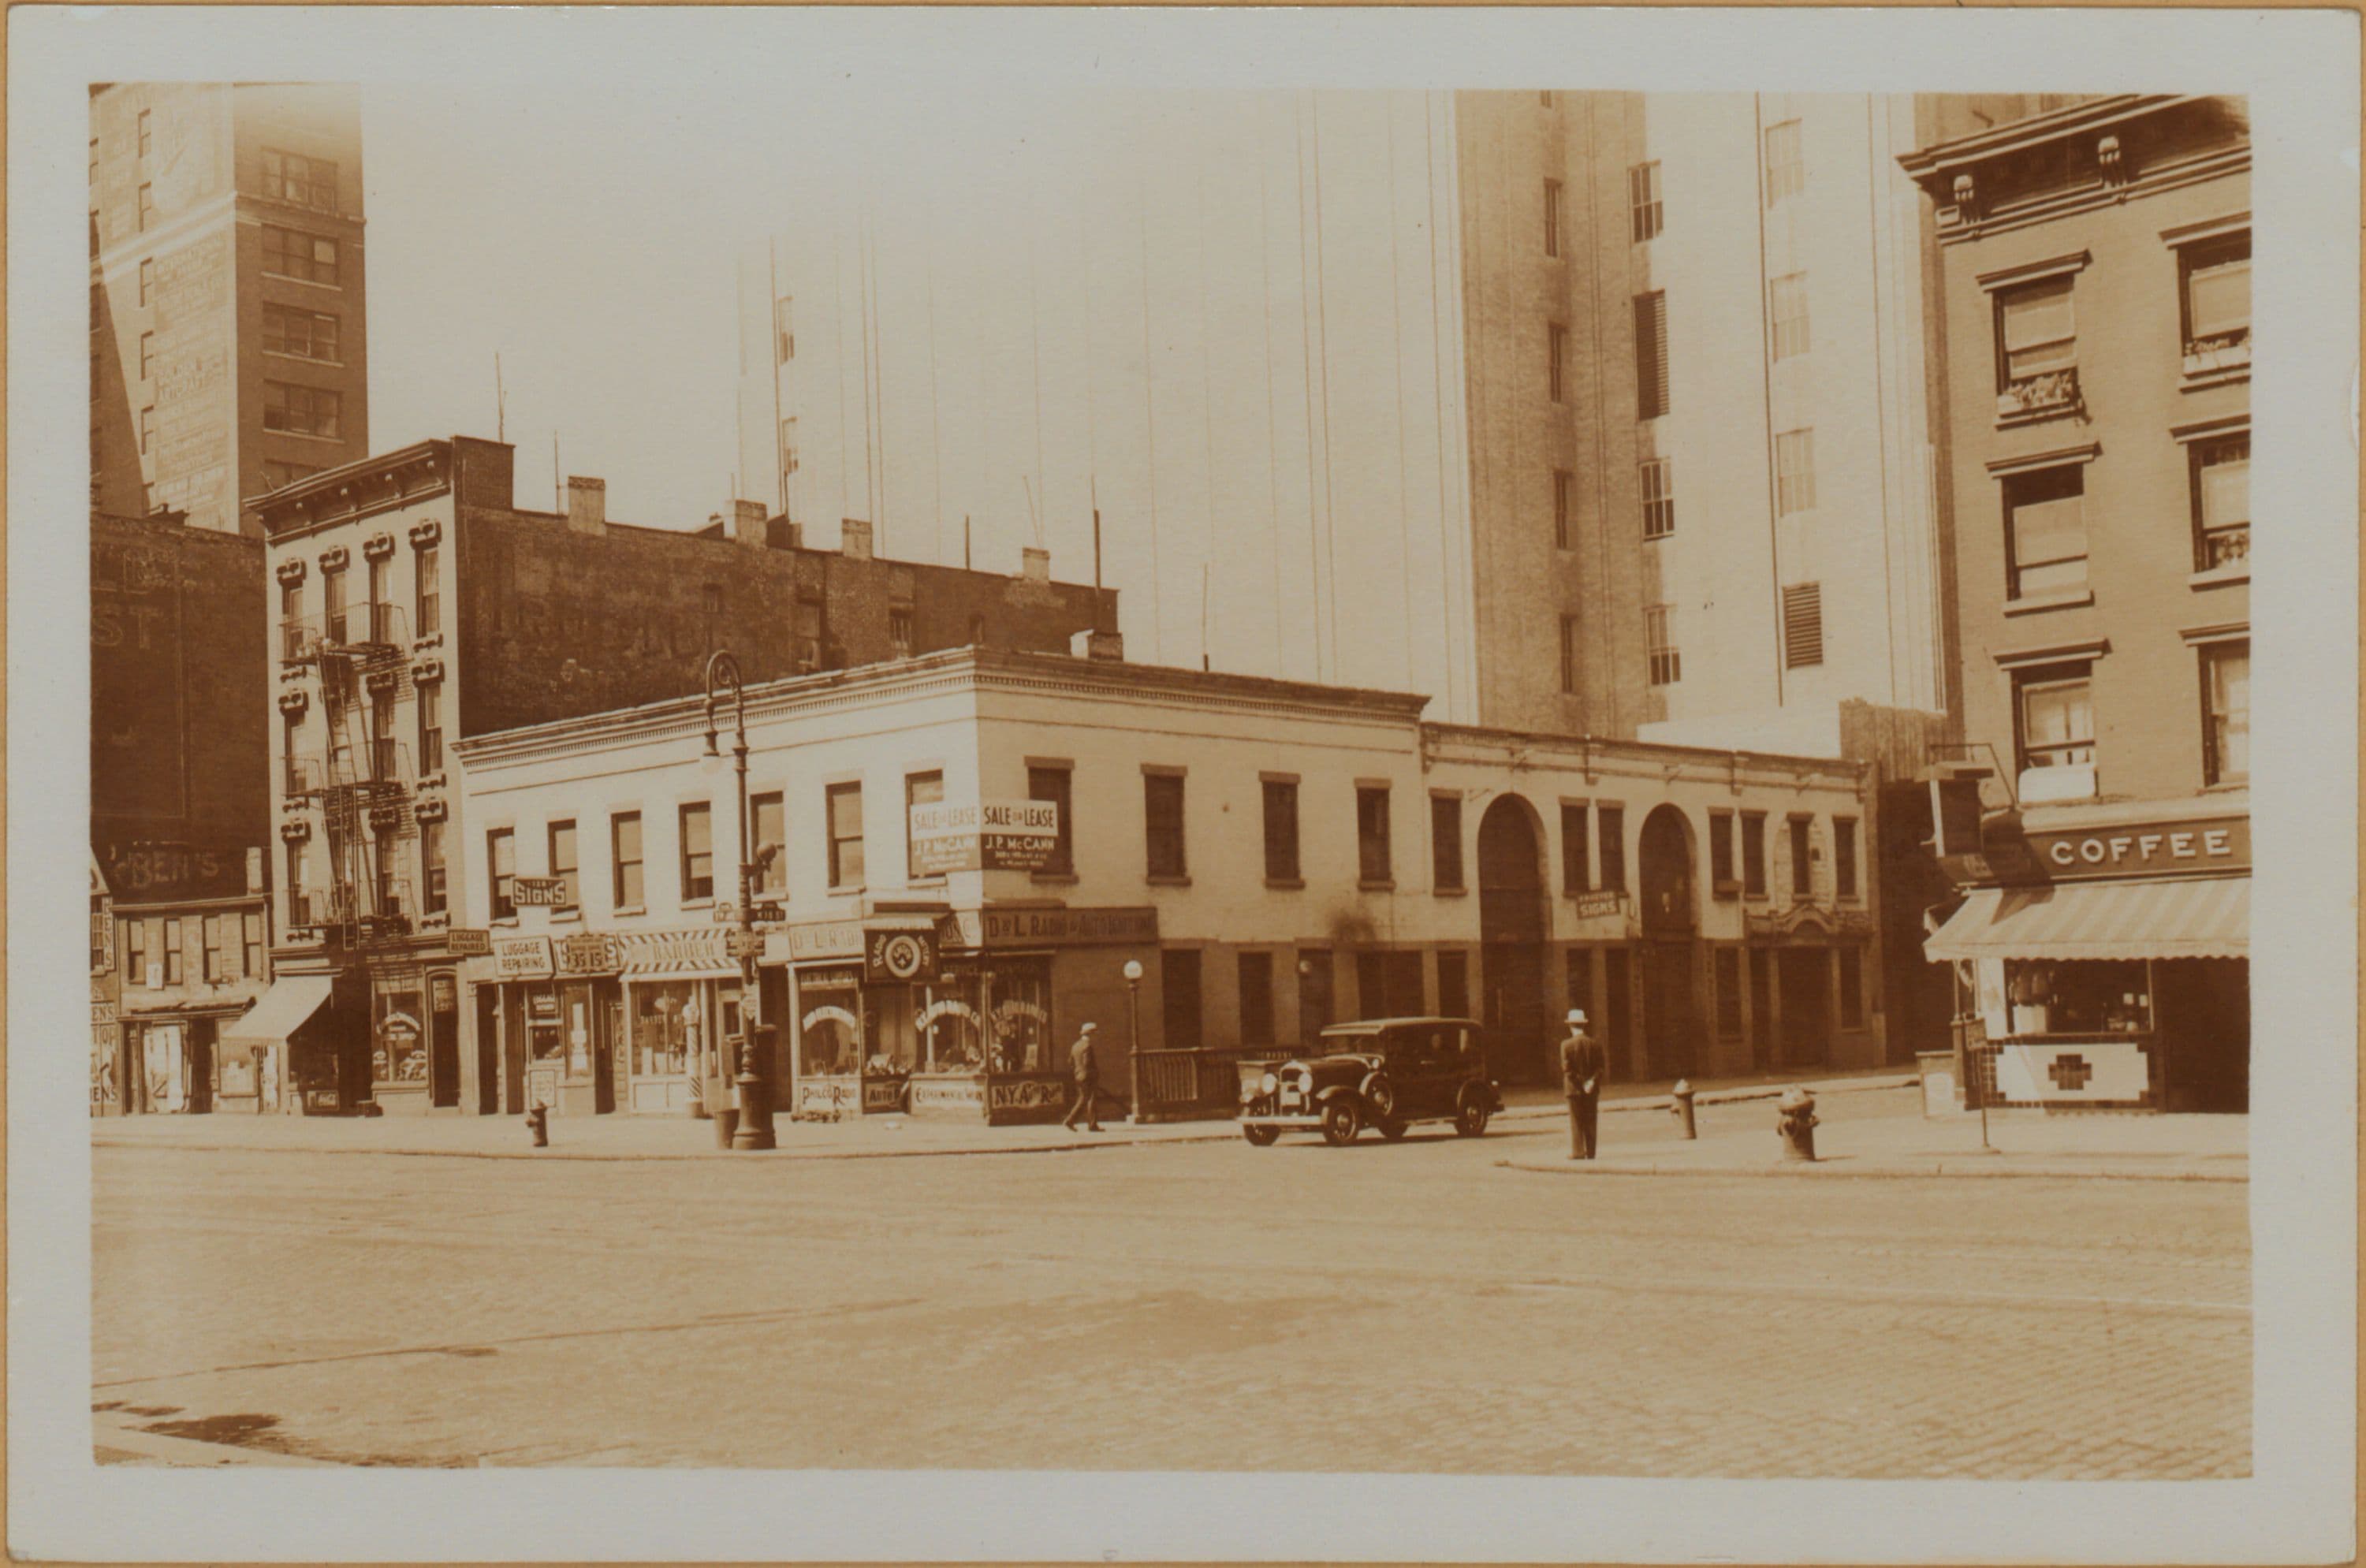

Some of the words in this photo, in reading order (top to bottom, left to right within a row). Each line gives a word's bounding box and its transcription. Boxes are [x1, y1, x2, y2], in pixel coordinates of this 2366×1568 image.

[984, 806, 1011, 826] SALE
[1023, 808, 1054, 828] LEASE
[2051, 829, 2232, 866] COFFEE
[515, 881, 564, 903] SIGNS
[1580, 900, 1616, 916] SIGNS
[452, 933, 483, 942] LUGGAGE
[451, 943, 486, 952] REPAIRED
[501, 941, 541, 956] LUGGAGE
[501, 957, 546, 971] REPAIRING
